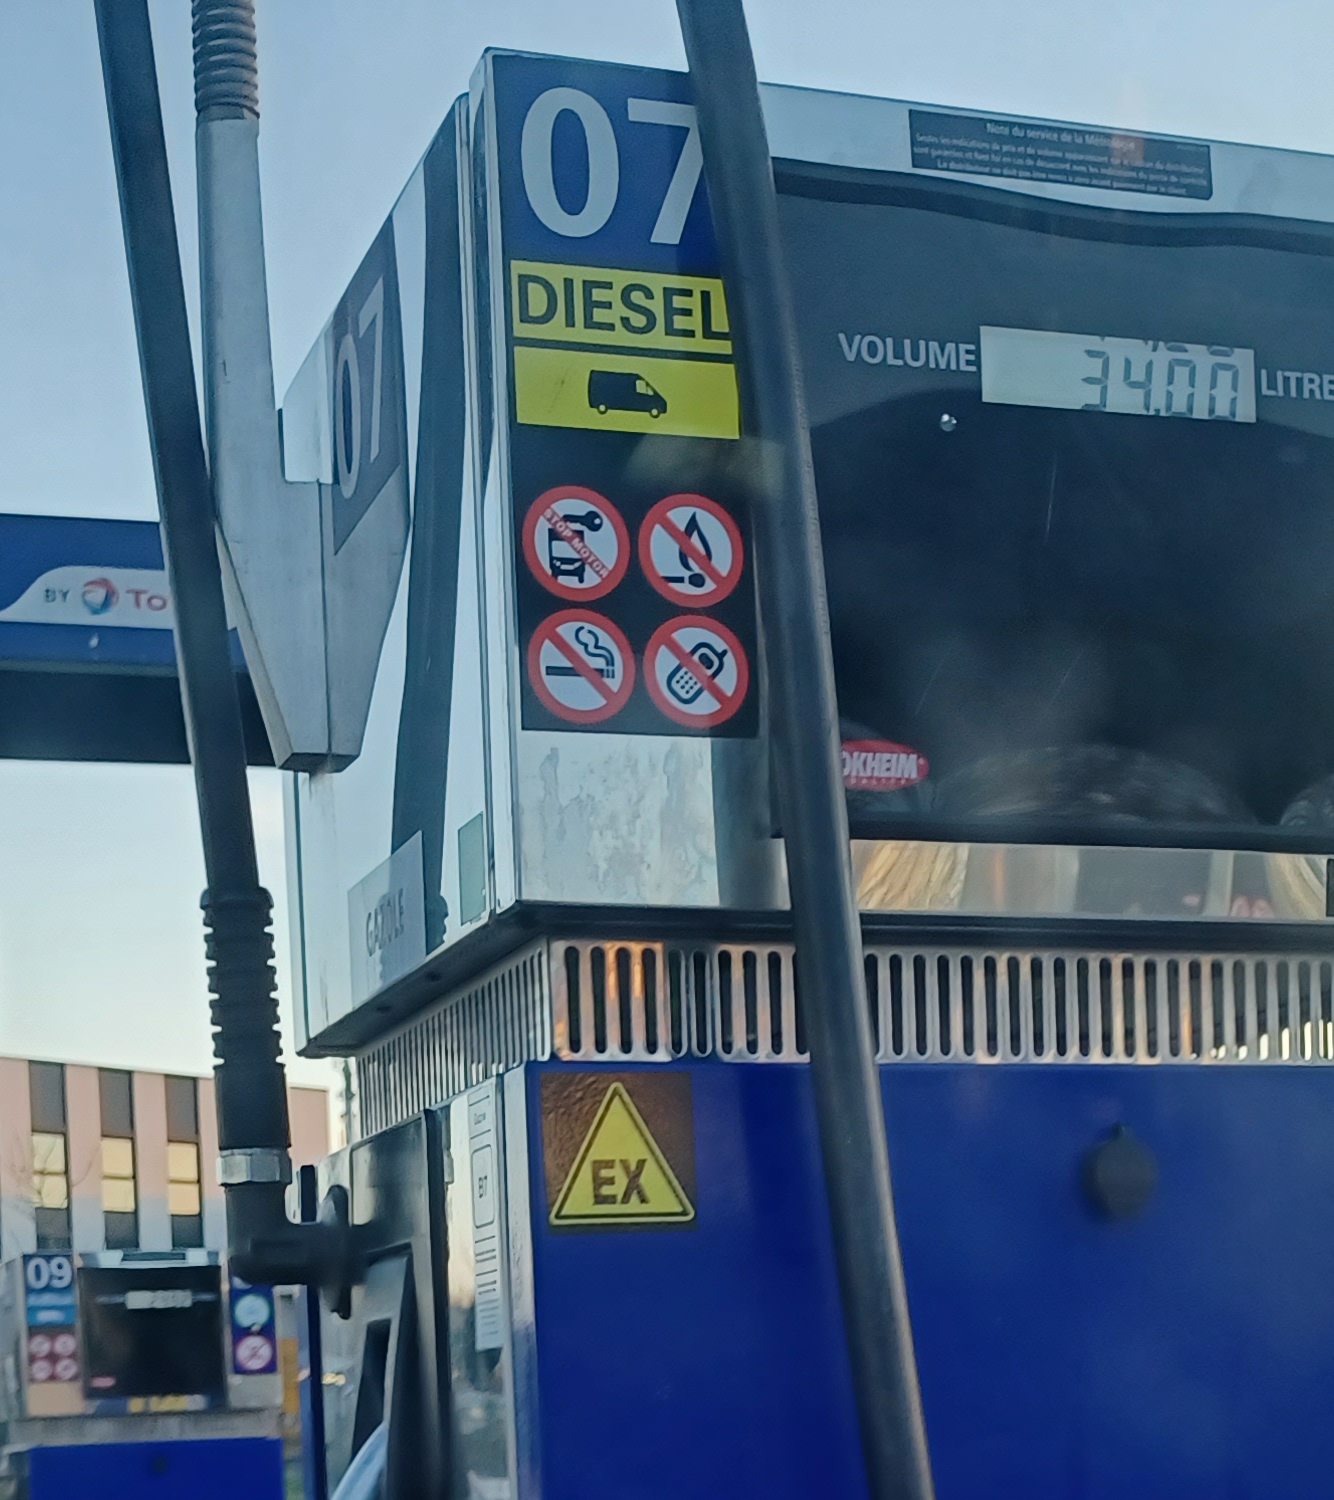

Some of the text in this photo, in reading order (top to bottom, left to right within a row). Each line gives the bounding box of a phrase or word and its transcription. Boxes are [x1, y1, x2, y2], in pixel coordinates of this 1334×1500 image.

[520, 86, 704, 245] 07
[517, 273, 731, 342] DIESEL
[335, 274, 384, 500] 07
[837, 332, 978, 373] VOLUME
[542, 507, 611, 580] STOP MOTOR
[591, 1157, 651, 1206] EX
[27, 1255, 73, 1290] 09
